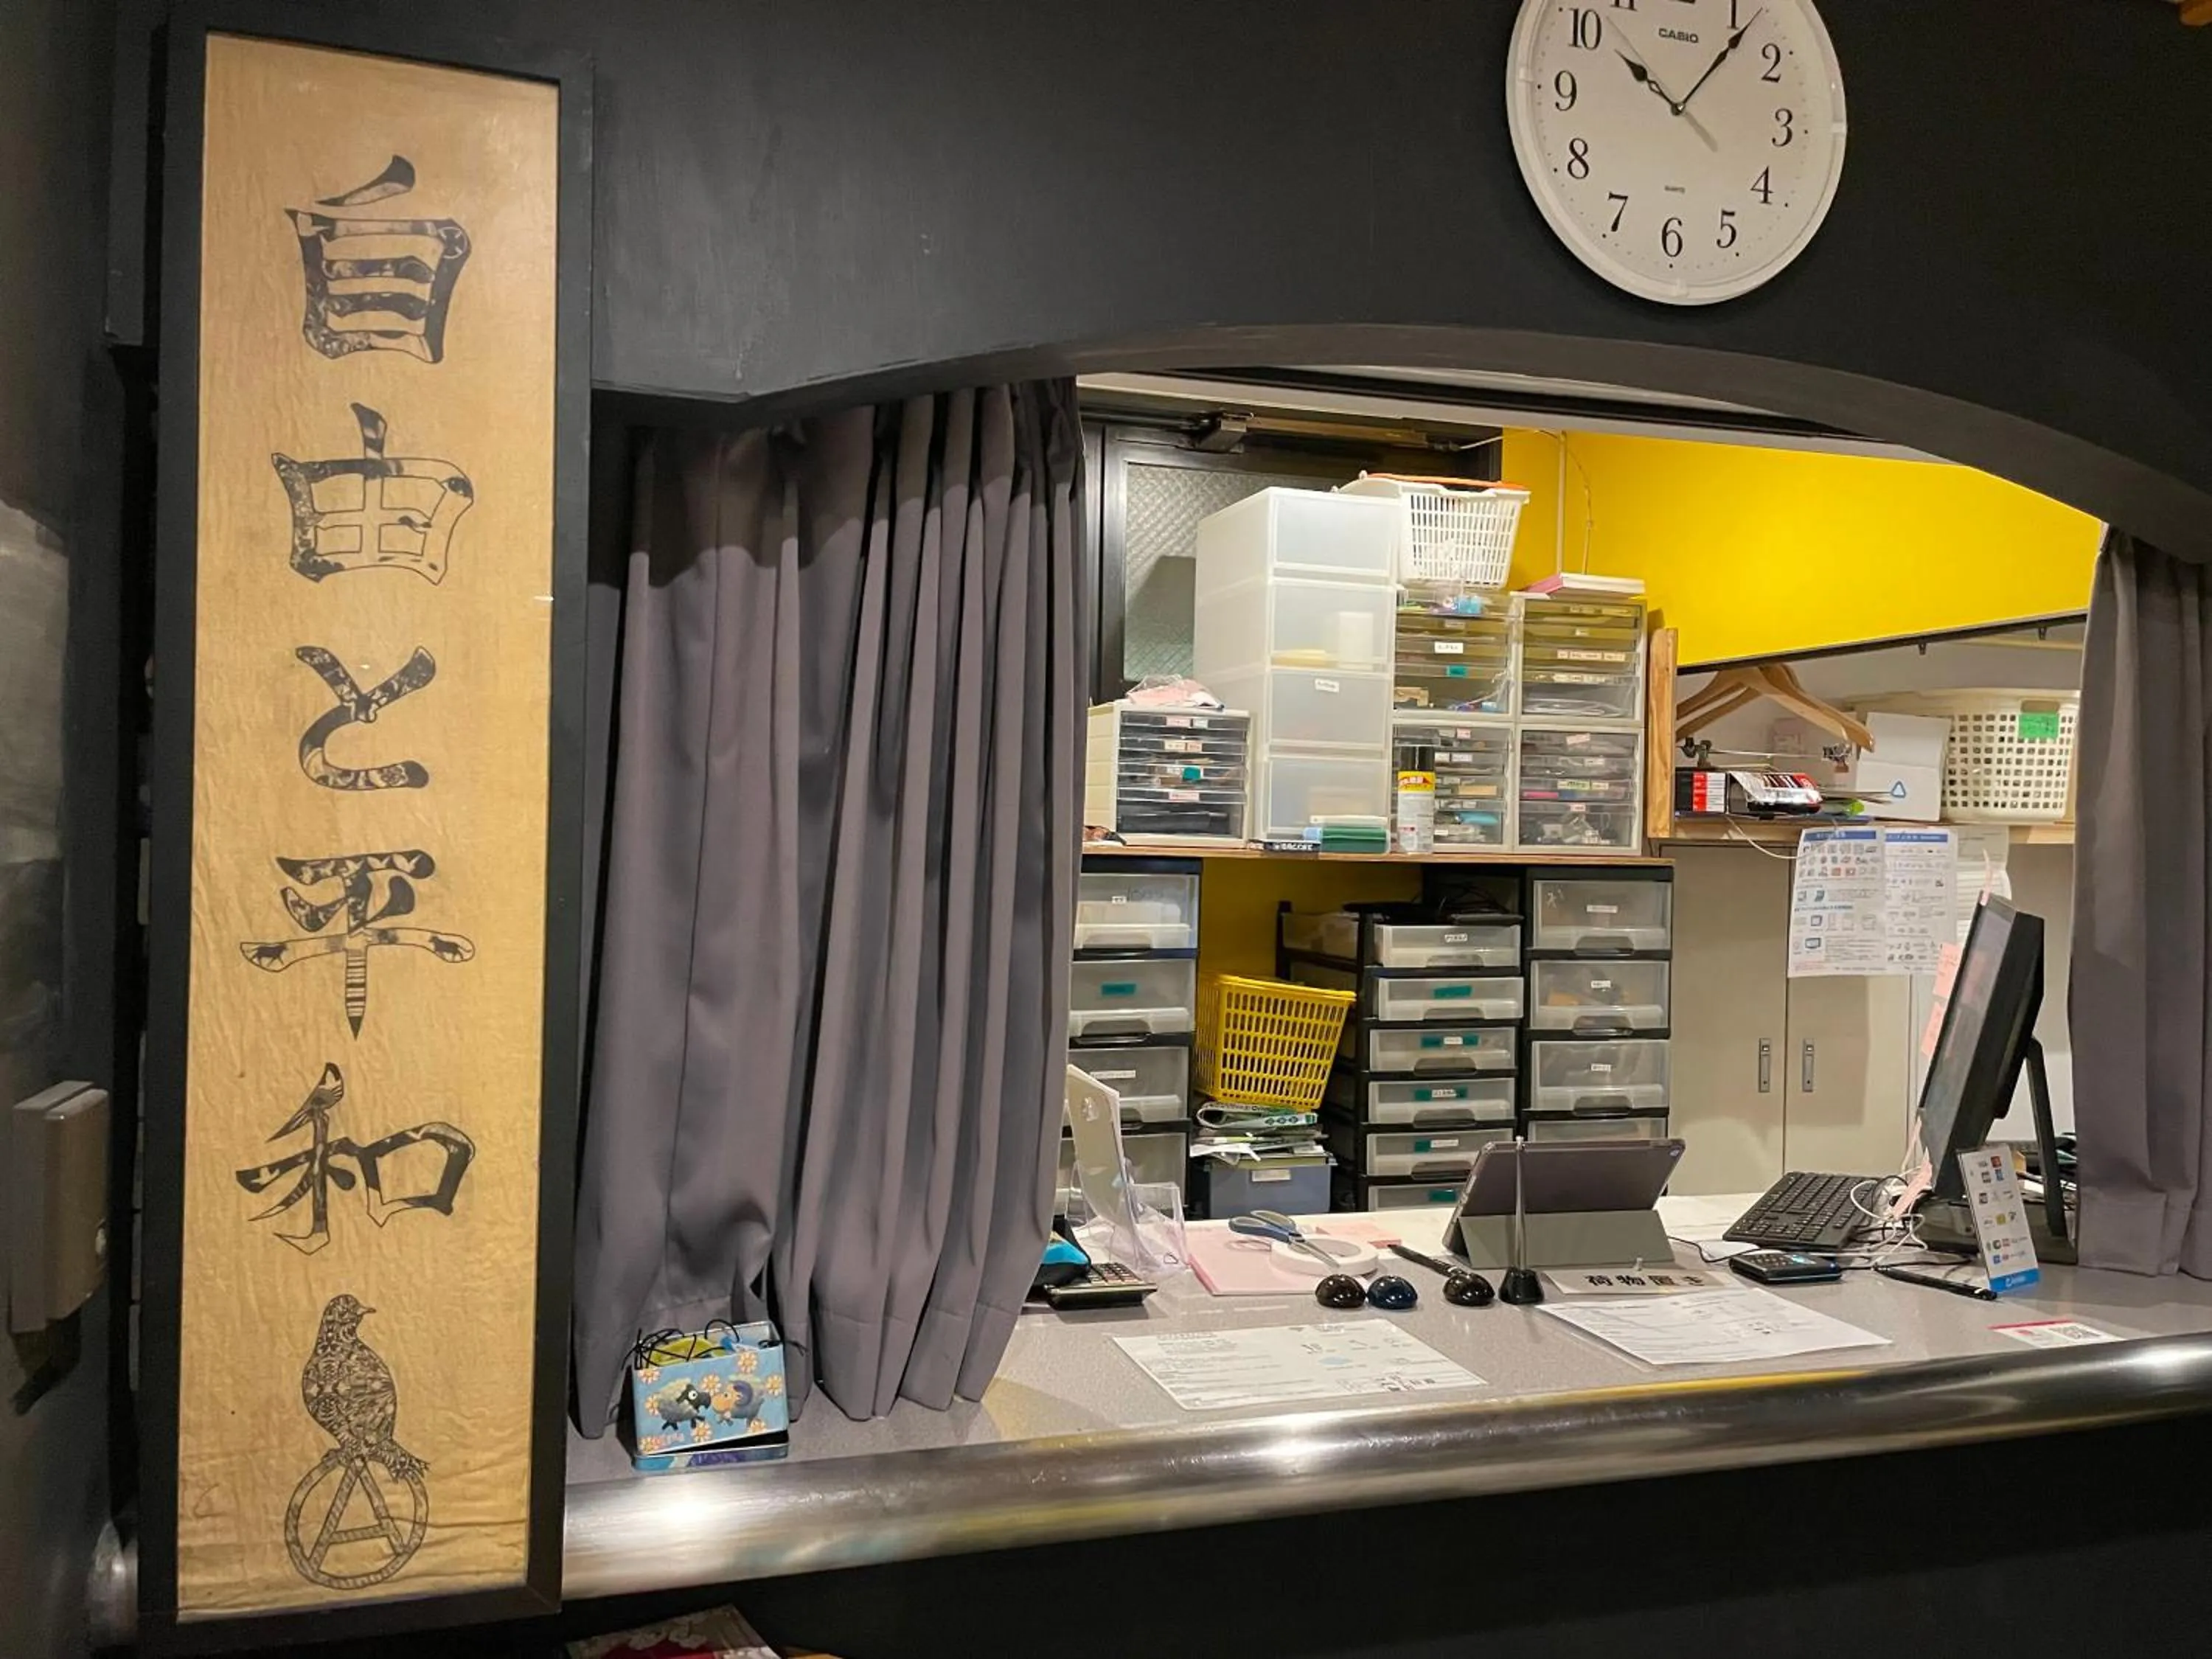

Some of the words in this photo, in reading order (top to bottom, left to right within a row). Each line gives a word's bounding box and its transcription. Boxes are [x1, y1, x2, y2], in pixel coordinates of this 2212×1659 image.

[1569, 8, 1602, 50] 10
[1658, 27, 1699, 44] CASIO
[1761, 43, 1781, 83] 2
[1554, 71, 1576, 111] 9
[1772, 108, 1793, 147] 3
[1568, 139, 1589, 178] 8
[1751, 167, 1773, 204] 4
[1607, 192, 1629, 232] 7
[1717, 210, 1736, 248] 5
[1662, 218, 1683, 257] 6
[236, 153, 476, 1255] 自由と平和
